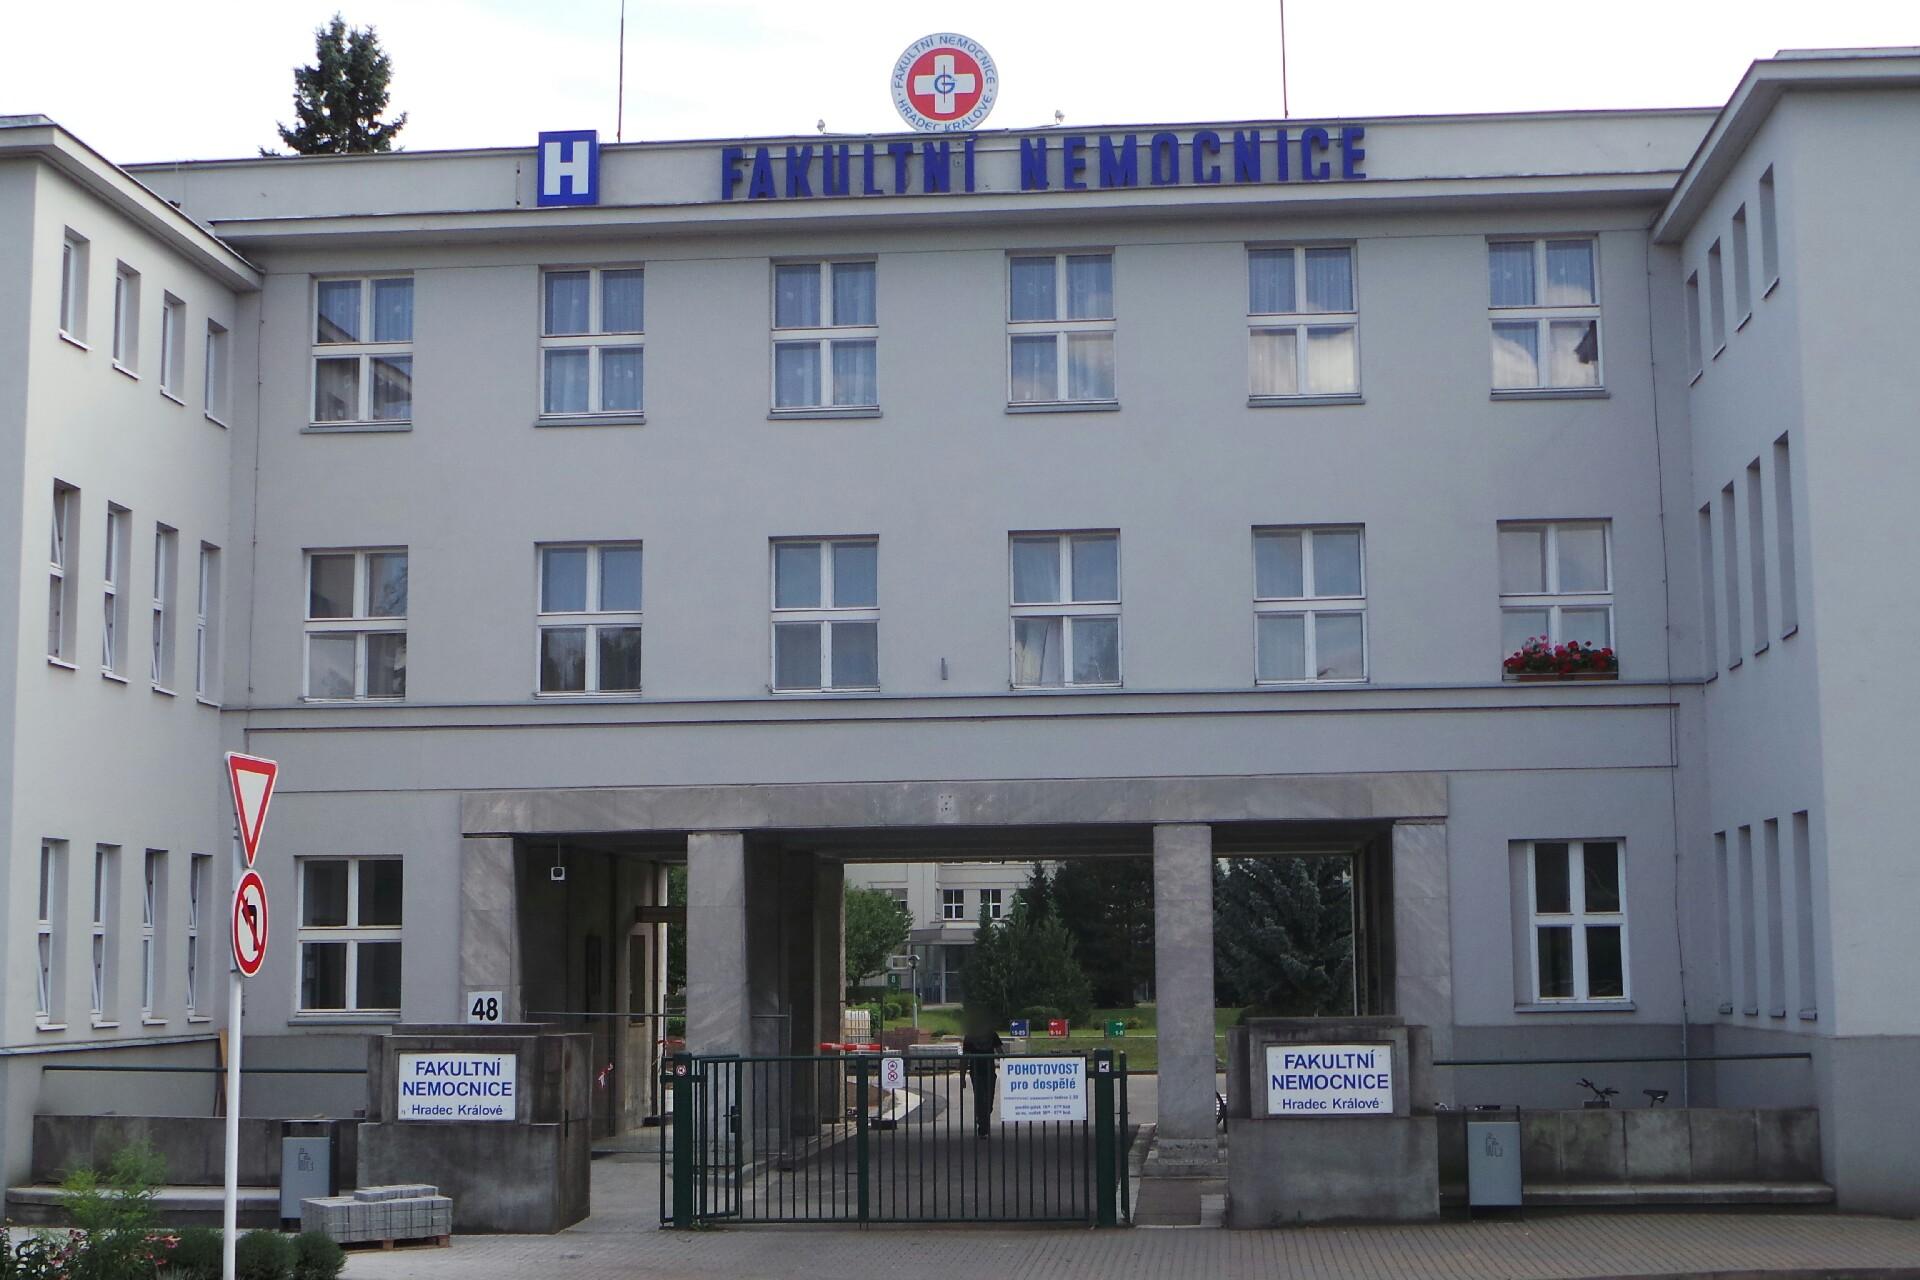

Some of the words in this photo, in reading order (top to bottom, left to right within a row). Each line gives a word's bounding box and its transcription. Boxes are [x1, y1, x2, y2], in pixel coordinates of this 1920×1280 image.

[939, 35, 996, 85] NEMOCNICE
[897, 98, 941, 131] HRADEC
[543, 140, 590, 196] H
[721, 134, 977, 201] FAKULTNÍ
[1020, 127, 1367, 191] NEMOCNICE
[471, 997, 499, 1021] 48
[415, 1057, 502, 1076] FAKULTNÍ
[1284, 1049, 1375, 1070] FAKULTNÍ
[1007, 1063, 1080, 1076] POHOTOVOST
[402, 1081, 513, 1097] NEMOCNICE
[1010, 1080, 1029, 1092] pro
[1033, 1078, 1076, 1092] dospělé
[1272, 1073, 1389, 1090] NEMOCNICE
[411, 1104, 453, 1116] Hradec
[458, 1103, 503, 1116] Králové
[1282, 1098, 1327, 1110] Hradec
[1332, 1097, 1379, 1109] Králové
